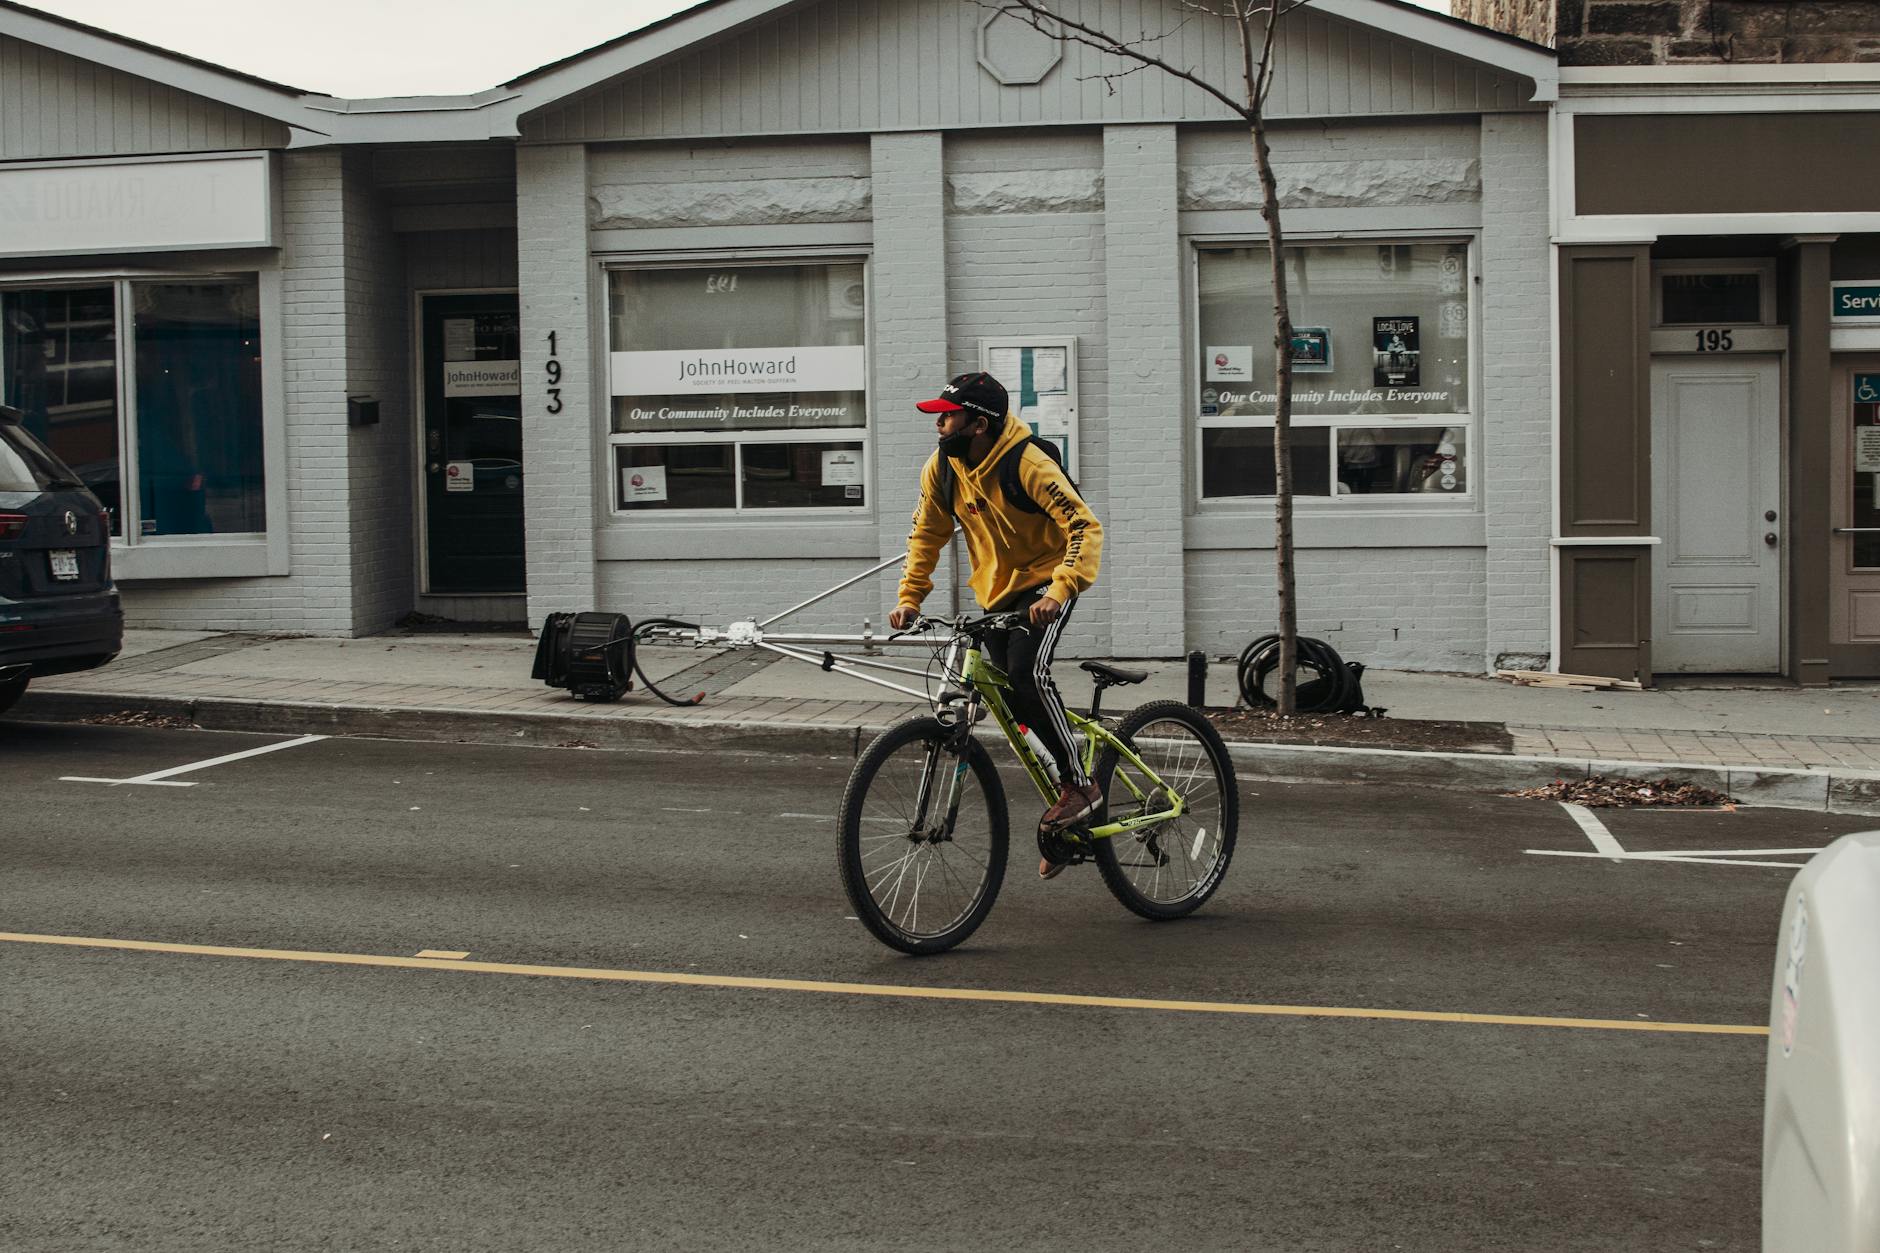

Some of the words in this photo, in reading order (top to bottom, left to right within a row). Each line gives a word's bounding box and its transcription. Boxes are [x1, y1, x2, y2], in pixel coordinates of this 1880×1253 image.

[1695, 329, 1733, 351] 195
[447, 369, 518, 384] JohnHoward
[546, 330, 563, 414] 193
[679, 356, 796, 380] JohnHoward
[1219, 391, 1246, 403] Our
[1249, 390, 1325, 404] Comunity
[1327, 389, 1383, 402] Includes
[1386, 389, 1448, 403] Everyone
[630, 408, 655, 420] Our
[658, 406, 729, 420] Community
[732, 405, 785, 418] Includes
[788, 405, 847, 418] Everyone
